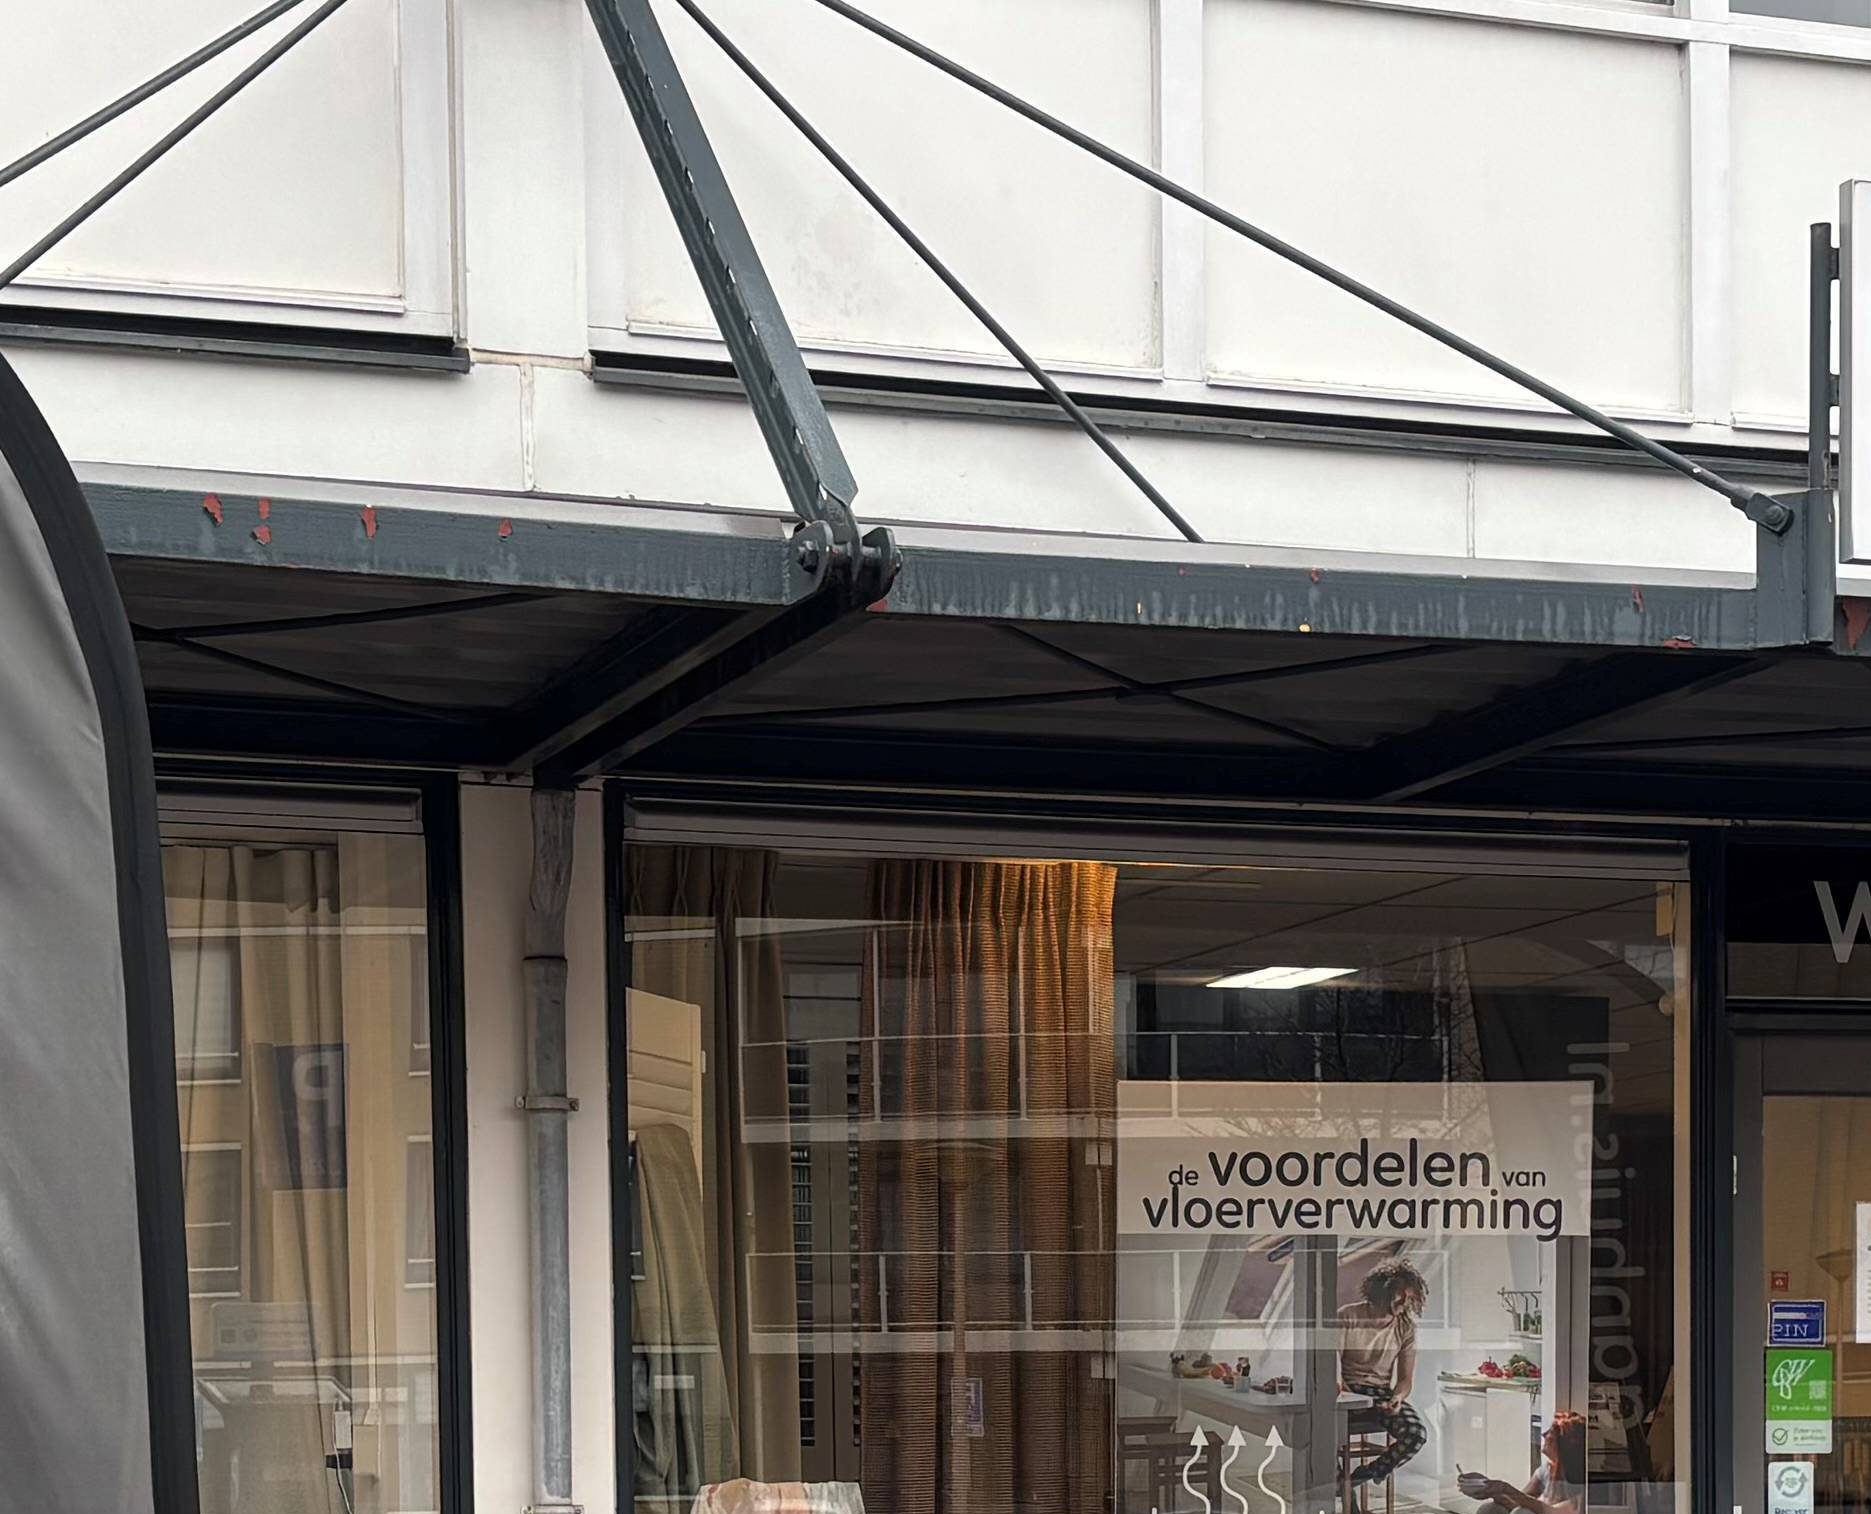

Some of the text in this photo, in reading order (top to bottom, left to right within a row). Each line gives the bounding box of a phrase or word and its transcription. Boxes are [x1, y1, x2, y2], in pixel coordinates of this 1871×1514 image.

[1168, 1138, 1546, 1188] de voordelen van
[1142, 1186, 1565, 1242] vloerverwarming
